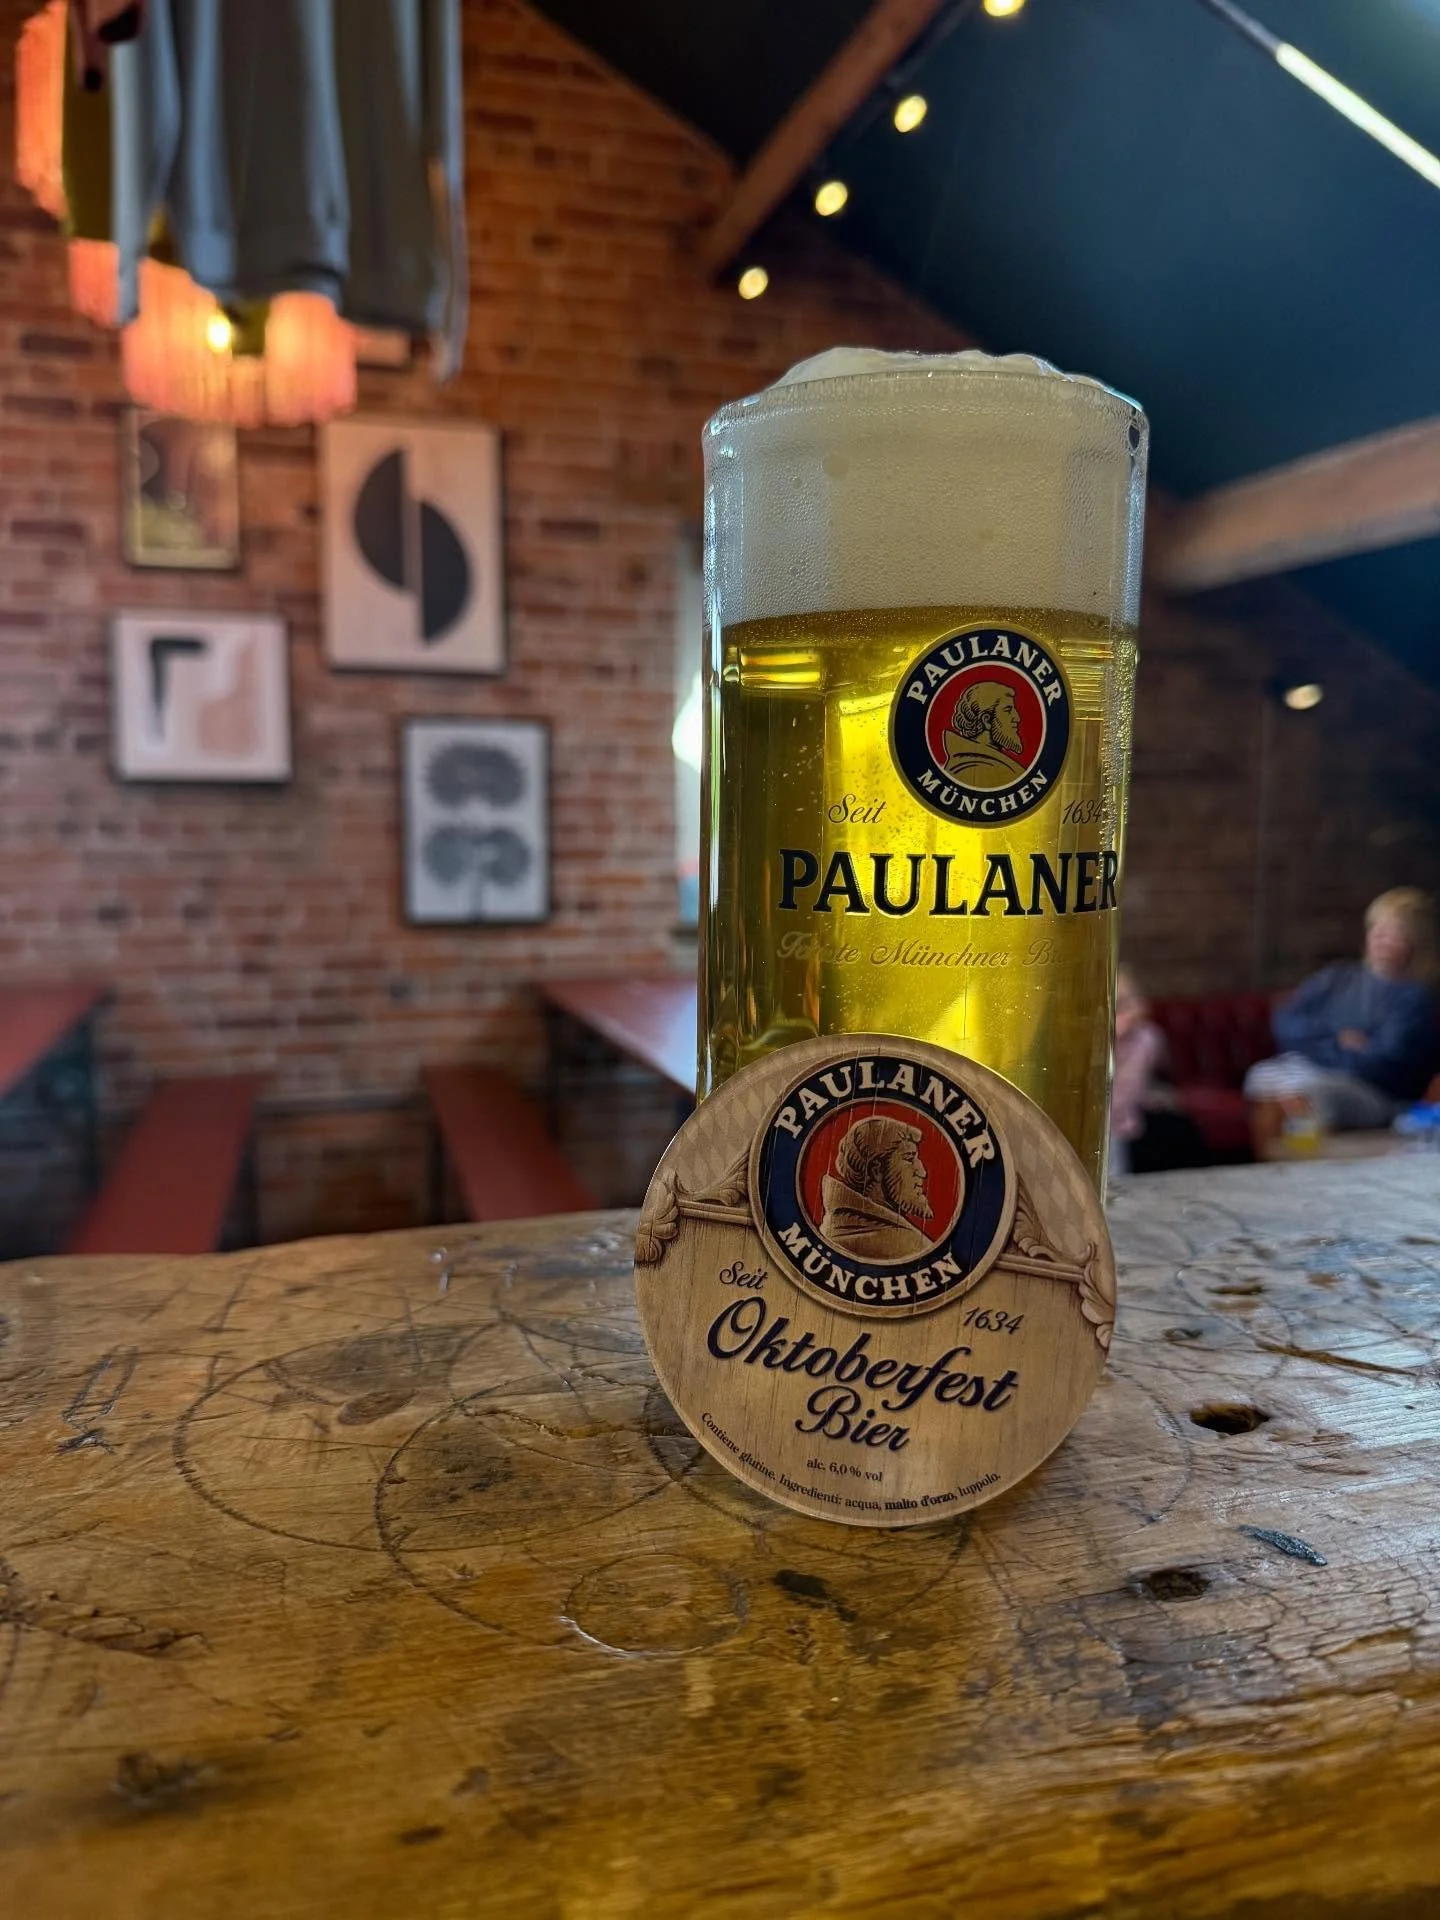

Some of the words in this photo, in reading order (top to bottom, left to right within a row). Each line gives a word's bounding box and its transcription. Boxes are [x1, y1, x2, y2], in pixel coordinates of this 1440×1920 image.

[907, 635, 1063, 707] PAULANER
[828, 793, 888, 824] Seit
[917, 769, 1049, 816] MÜNCHEN
[1062, 799, 1104, 824] 1634
[778, 849, 1119, 917] PAULANER
[870, 939, 1009, 967] Münchner
[774, 1060, 998, 1170] PAULANER
[719, 1260, 769, 1290] Seit
[777, 1222, 964, 1301] MÜNCHEN
[962, 1306, 1024, 1335] 1634
[706, 1296, 1018, 1412] Oktoberfest
[795, 1384, 911, 1451] Bier
[702, 1412, 740, 1454] Contiene
[738, 1450, 776, 1481] glutine.
[779, 1473, 842, 1505] Ingredienti:
[845, 1498, 882, 1511] acqua,
[885, 1499, 918, 1511] malto
[957, 1472, 1001, 1497] luppolo.
[806, 1458, 826, 1471] alc.
[865, 1471, 883, 1482] vol
